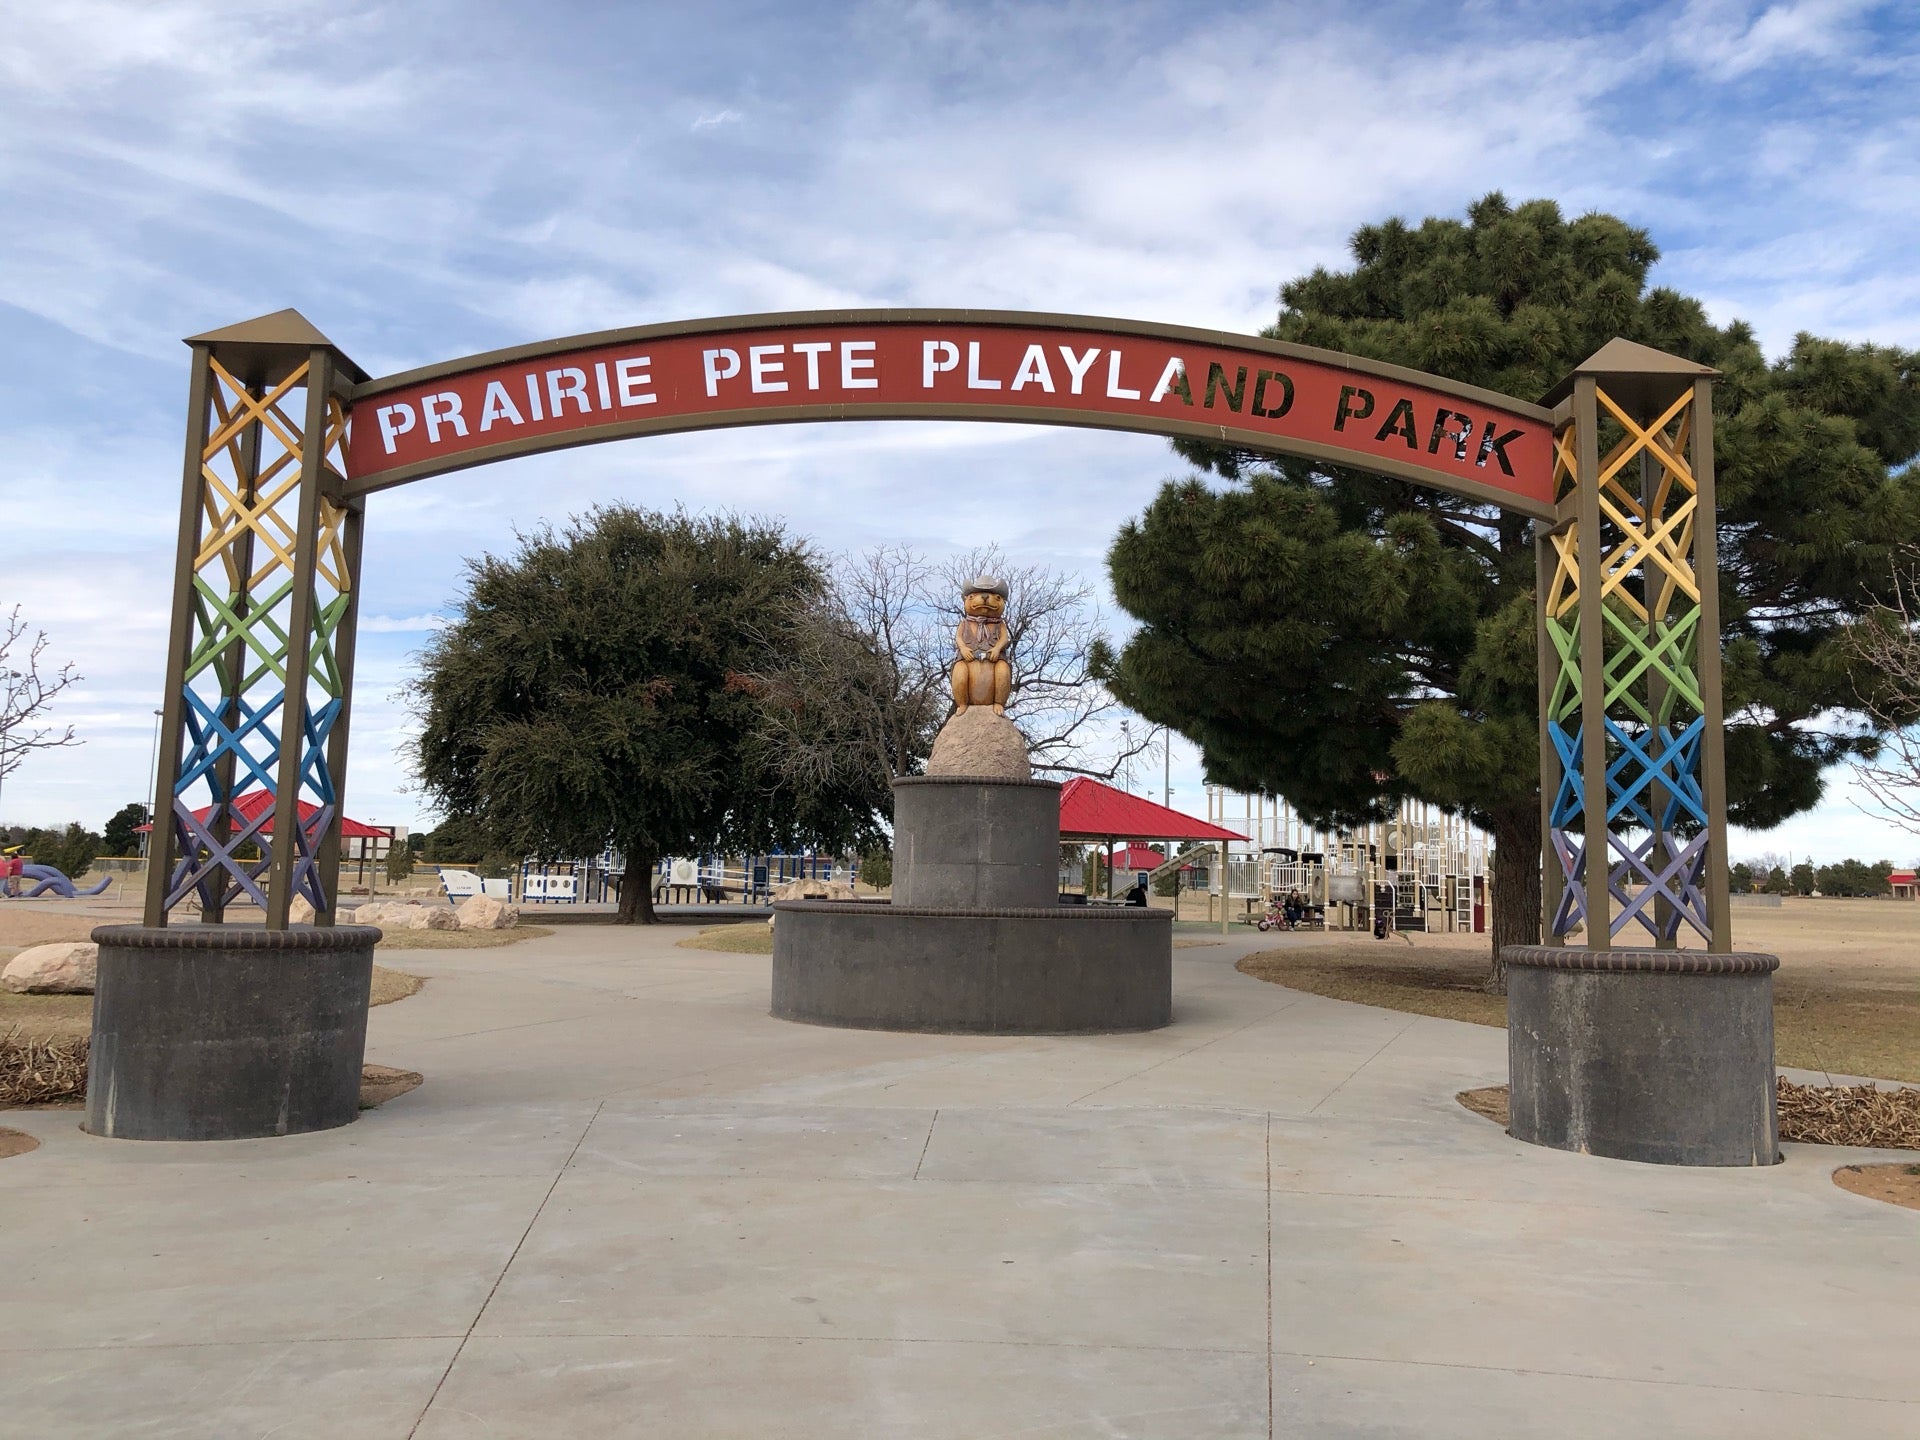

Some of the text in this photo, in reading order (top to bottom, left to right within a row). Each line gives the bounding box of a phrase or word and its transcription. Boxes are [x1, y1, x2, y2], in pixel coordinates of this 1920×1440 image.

[376, 340, 1525, 477] PRAIRIE PETE PLAYLAND PARK
